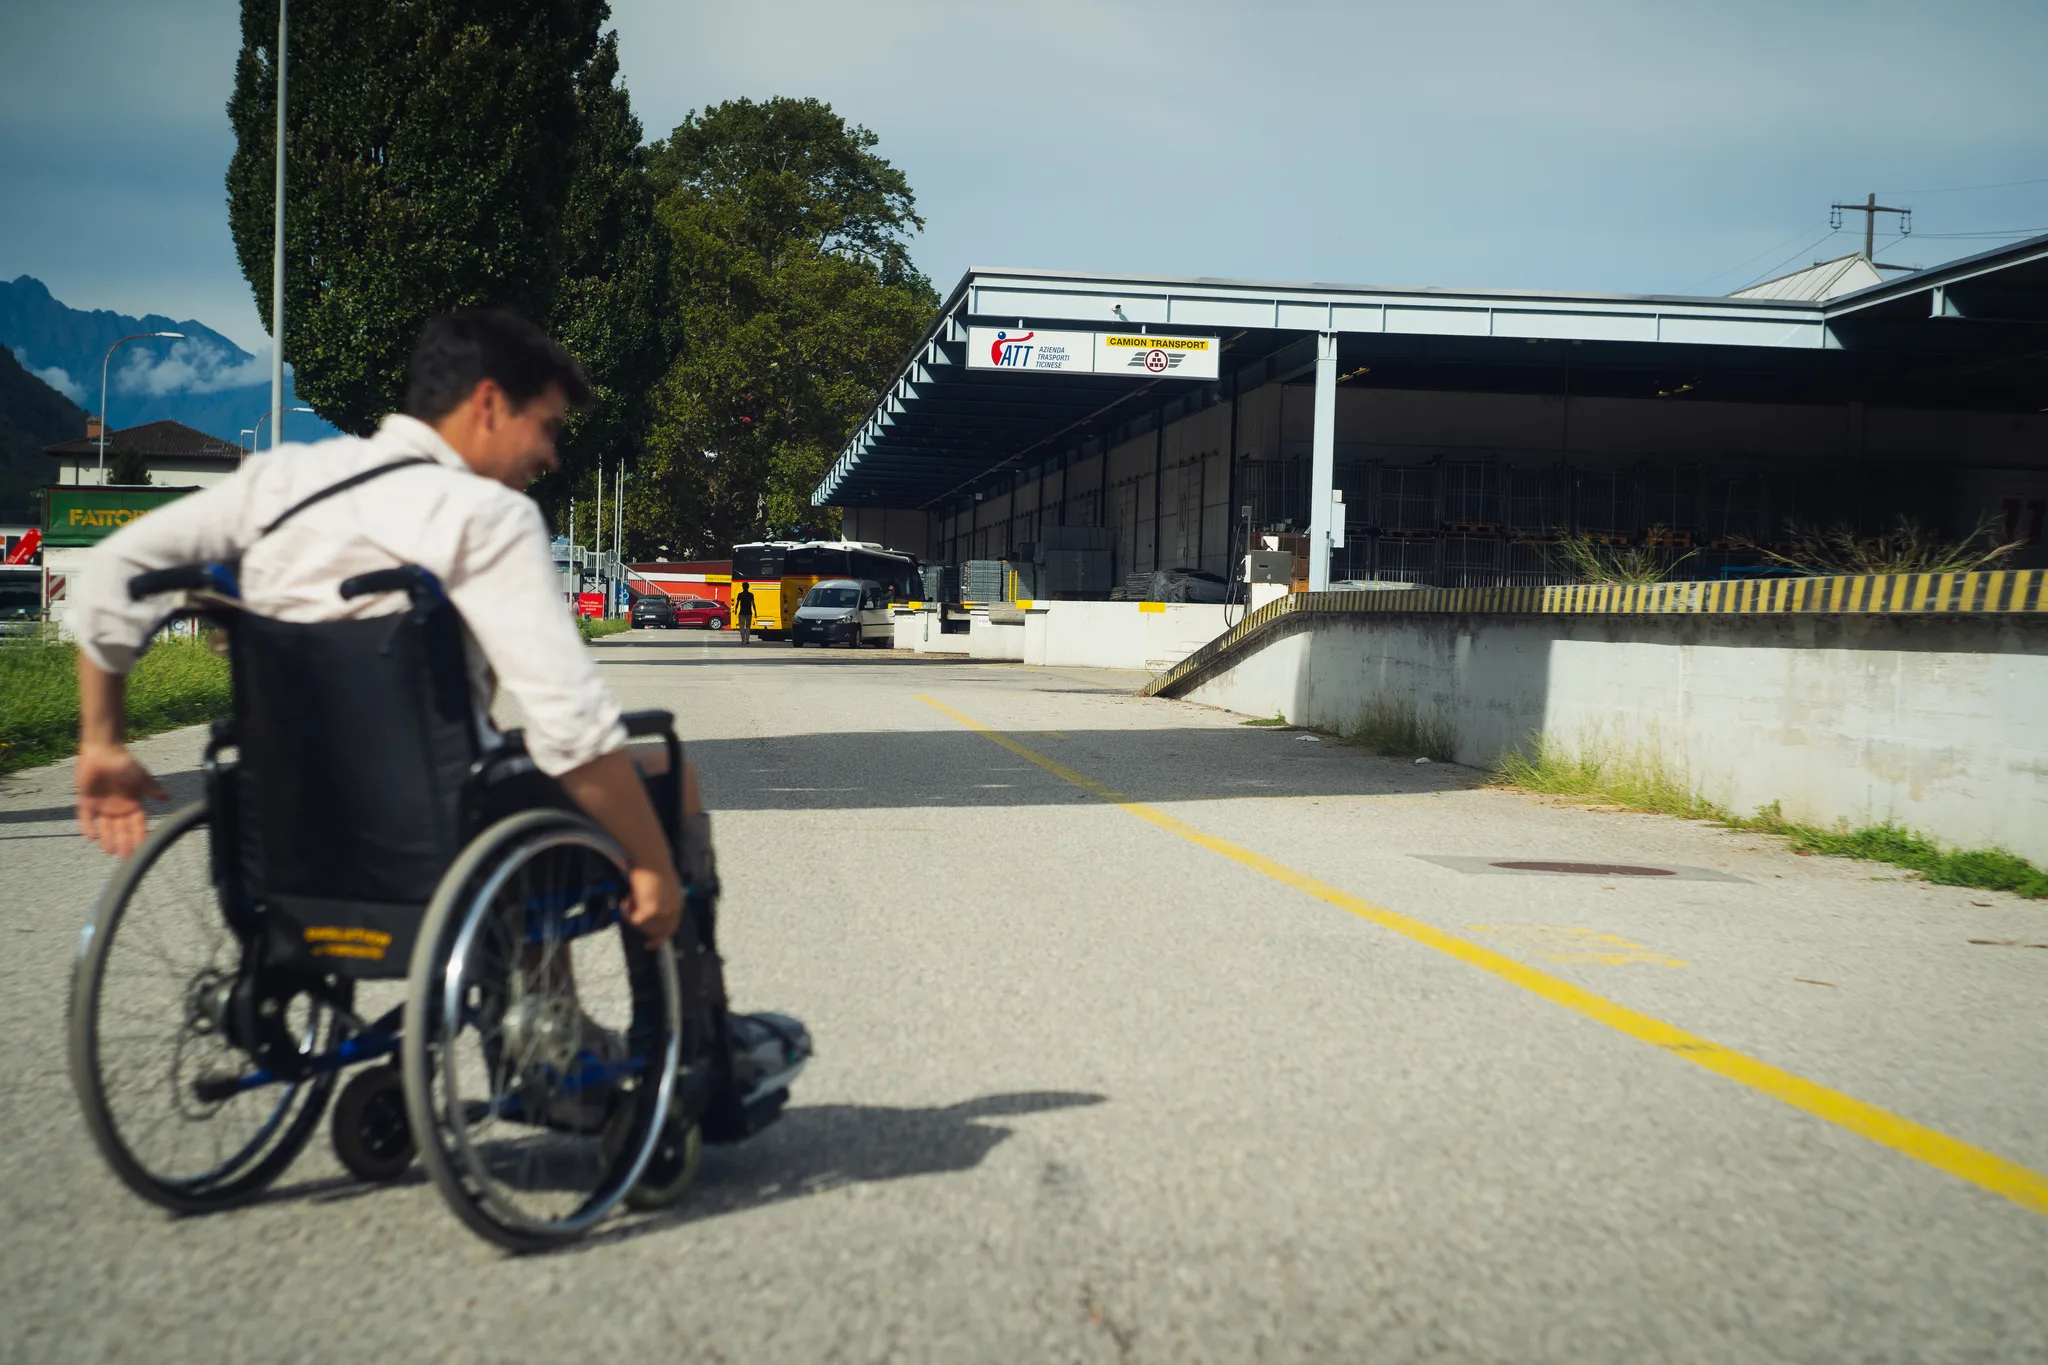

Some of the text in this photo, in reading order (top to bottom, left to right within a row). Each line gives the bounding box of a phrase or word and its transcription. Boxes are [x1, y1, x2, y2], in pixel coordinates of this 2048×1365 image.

[1110, 338, 1205, 349] CAMION TRANSPORT
[1039, 346, 1065, 354] AZIENDA
[1000, 345, 1034, 366] ATT
[1035, 361, 1062, 369] TICINESE
